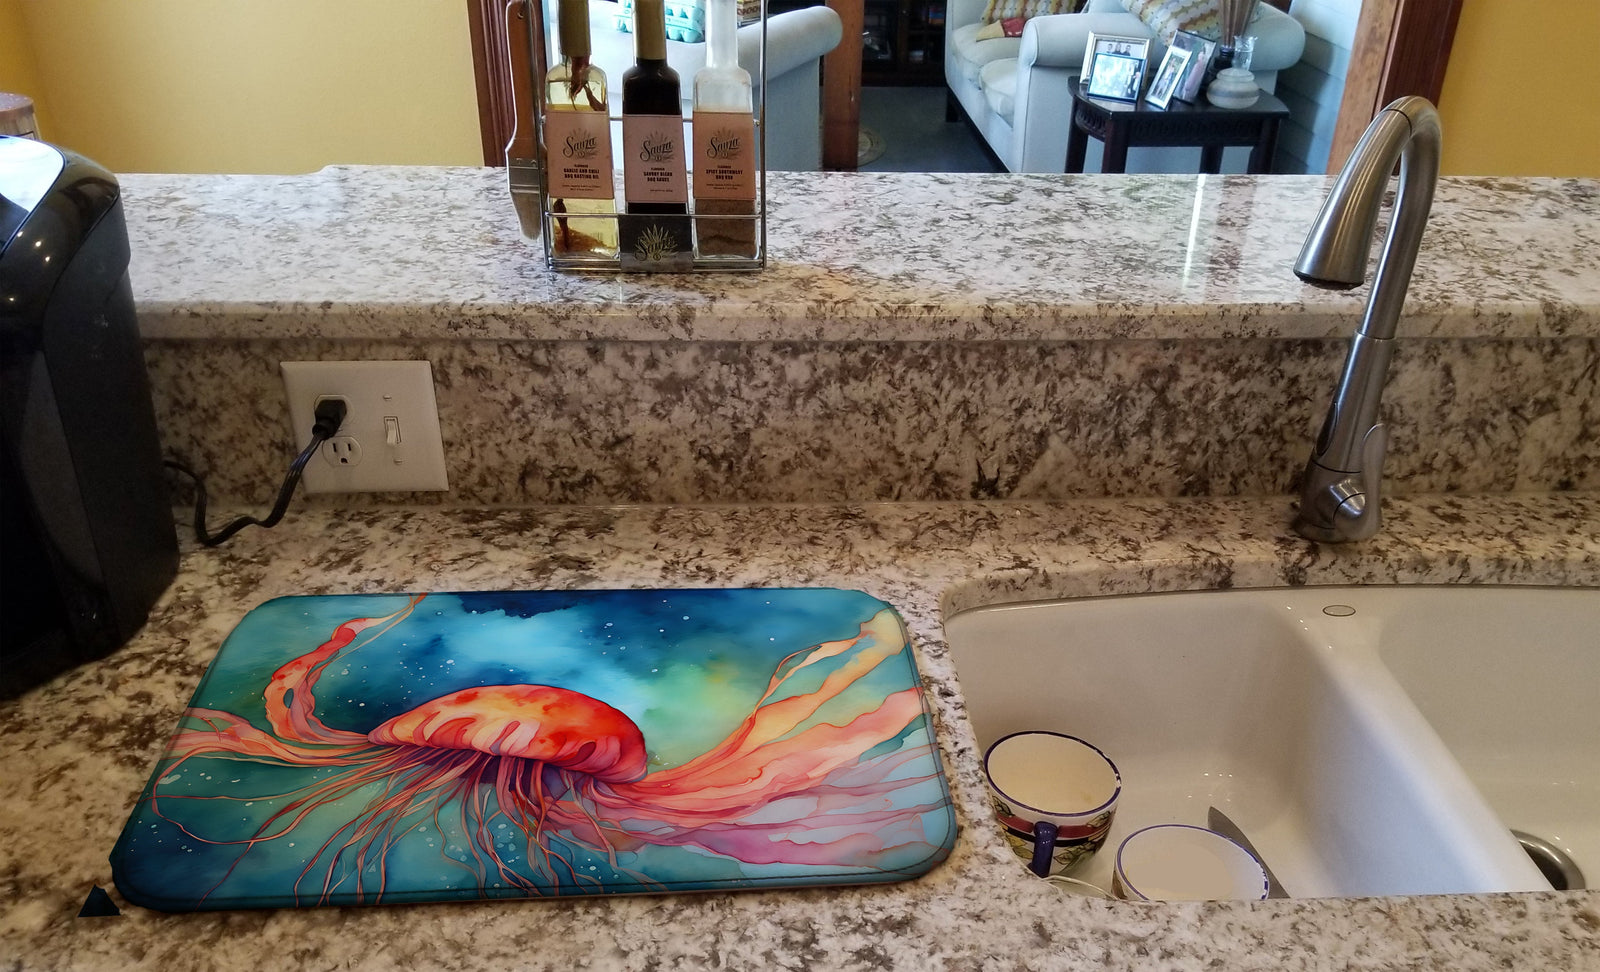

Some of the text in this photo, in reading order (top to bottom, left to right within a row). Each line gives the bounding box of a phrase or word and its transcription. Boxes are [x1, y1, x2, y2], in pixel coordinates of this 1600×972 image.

[563, 136, 598, 158] Sauza
[640, 140, 674, 161] Sauza
[707, 137, 740, 158] Sauza
